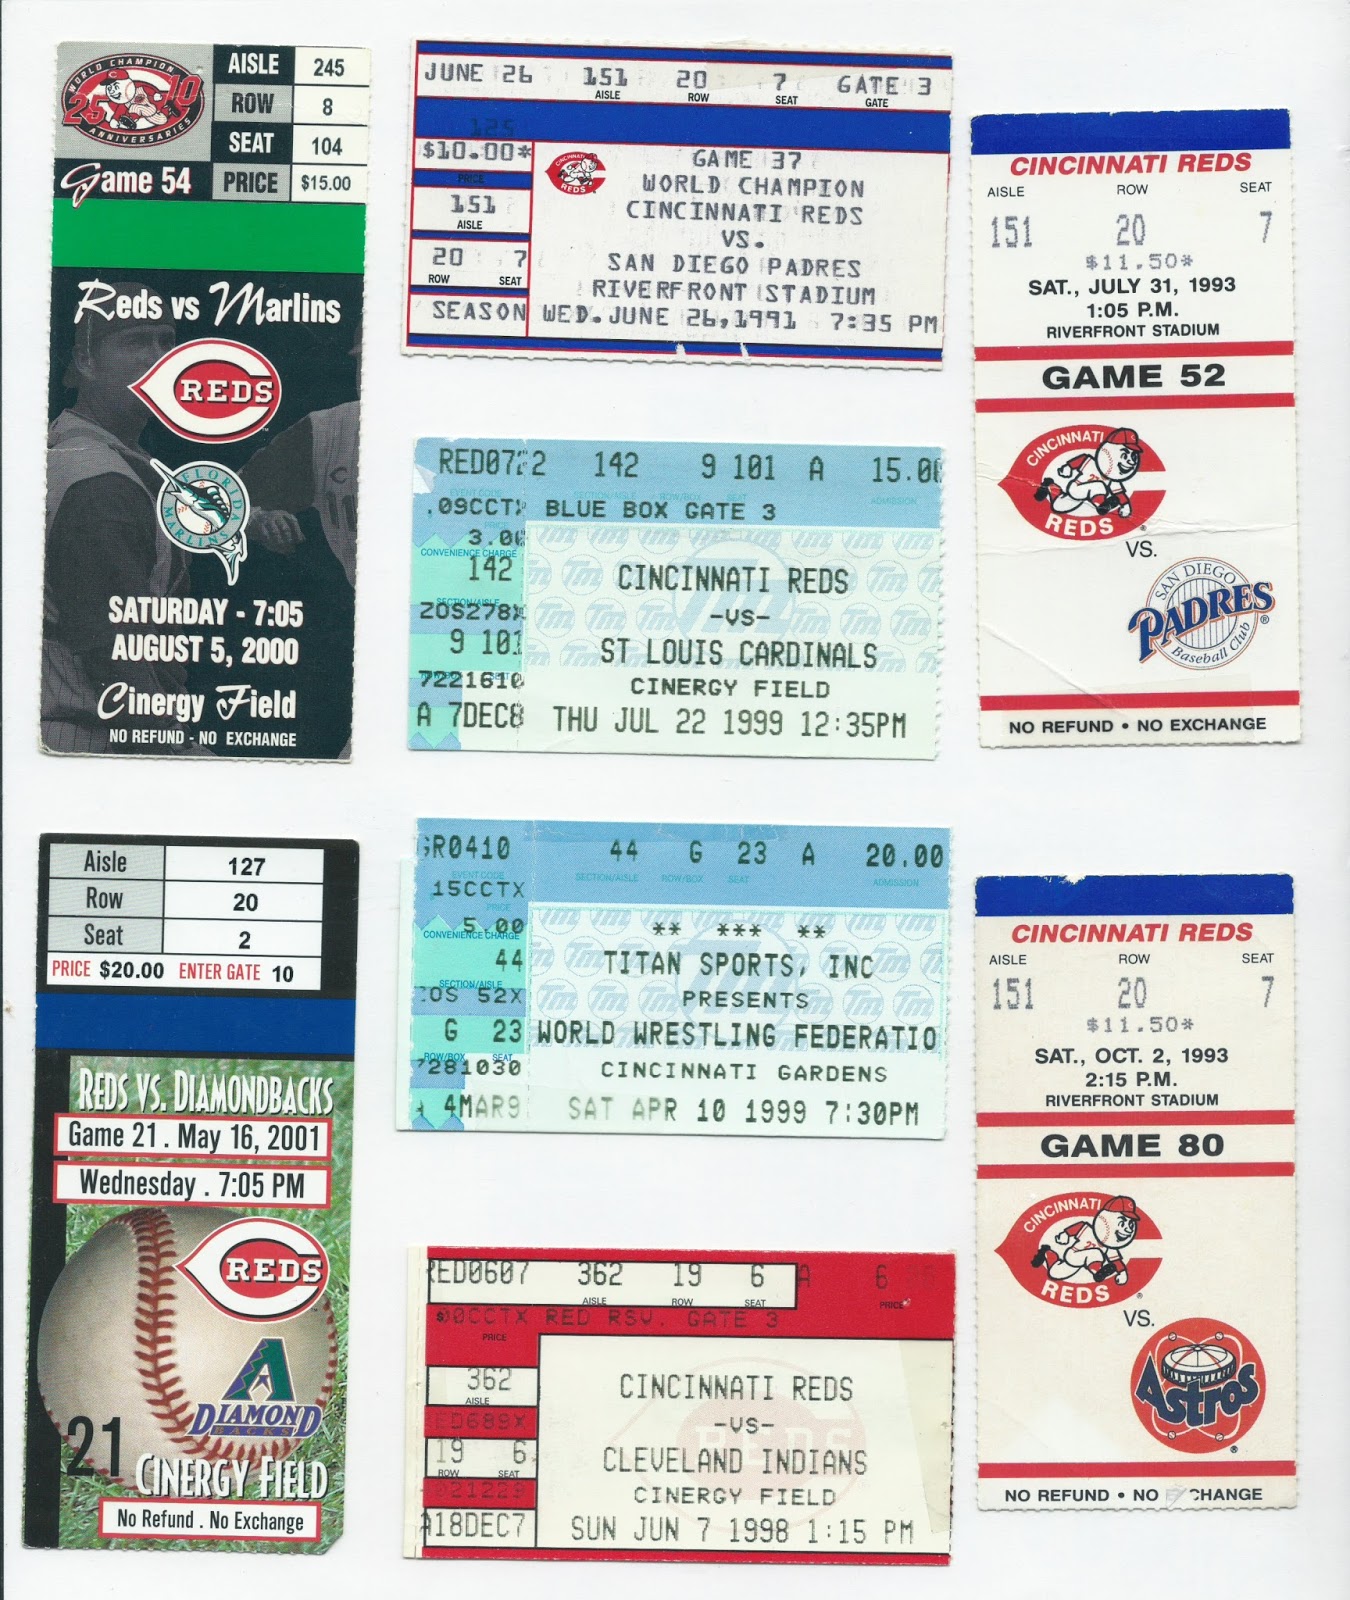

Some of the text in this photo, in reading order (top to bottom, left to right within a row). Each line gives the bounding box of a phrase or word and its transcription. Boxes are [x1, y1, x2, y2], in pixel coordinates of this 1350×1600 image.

[69, 57, 174, 94] WORLD CHAMPION
[228, 53, 344, 76] AISLE 245
[425, 63, 533, 83] JUNE 26
[595, 90, 888, 108] AISLE ROW SEAT GATE
[89, 118, 191, 144] ANNIVERSARIES
[693, 150, 801, 169] GAME 37
[1010, 153, 1252, 175] CINCINNATI REDS
[61, 163, 191, 209] Game 54
[223, 172, 351, 193] PRICE $15.00
[987, 182, 1272, 197] AISLE ROW SEAT
[608, 253, 861, 278] SAN DIEGO PADRES
[592, 279, 875, 305] RIVERFRONT STADIUM
[1029, 277, 1236, 296] SAT., JULY 31, 1993
[74, 278, 341, 326] Reds vs Marlins
[433, 301, 526, 321] SEASON
[1087, 303, 1178, 318] 1:05 P.M.
[831, 313, 891, 332] 7:35
[909, 315, 937, 333] PM
[1042, 364, 1226, 389] GAME 52
[180, 379, 273, 406] REDS
[595, 451, 639, 478] 142
[546, 501, 776, 520] BLUE BOX GATE 3
[421, 548, 517, 558] CONVENIENCE CHARGE
[618, 563, 849, 594] CINCINNATI REDS
[109, 596, 303, 627] SATURDAY 7:05
[710, 609, 770, 626] -VS-
[1128, 581, 1276, 663] PADRES
[111, 634, 299, 667] AUGUST 5, 2000
[601, 637, 877, 669] ST LOUIS CARDINALS
[1172, 622, 1250, 664] Baseball Club
[630, 677, 829, 698] CINERGY FIELD
[553, 706, 906, 738] THU JUL 22 1999 12:35PM
[110, 730, 296, 746] NO REFUND NO EXCHANGE
[84, 851, 266, 876] Aisle 127
[610, 839, 943, 867] 44 23 20.00
[424, 930, 520, 940] CONVENIENCE CHARGE
[1012, 923, 1253, 944] CINCINNATI REDS
[52, 960, 294, 982] PRICE $20.00 ENTER GATE 10
[604, 950, 873, 979] TITAN SPORTS, INC
[439, 980, 502, 989] SECTION/AISLE
[683, 991, 809, 1008] PRESENTS
[538, 1020, 936, 1050] WORLD WRESTLING FEDERATIO
[1035, 1048, 1228, 1065] SAT., OCT. 2, 1993
[601, 1061, 888, 1082] CINCINNATI GARDENS
[1086, 1072, 1177, 1087] 2:15 P.M.
[79, 1068, 334, 1116] REDS VS. DIAMONDBACKS
[1046, 1094, 1219, 1106] RIVERFRONT STADIUM
[569, 1097, 918, 1126] SAT APR 10 1999 7:30PM
[69, 1121, 319, 1153] Game 21 May 16, 2001
[1041, 1134, 1224, 1157] GAME 80
[80, 1169, 304, 1199] Wednesday 7:05 PM
[583, 1297, 606, 1305] AISLE
[672, 1298, 693, 1307] ROW
[620, 1373, 853, 1401] CINCINNATI REDS
[1135, 1353, 1262, 1427] Astros
[603, 1446, 867, 1475] CLEVELAND INDIANS
[135, 1453, 329, 1499] CINERGY FIELD
[634, 1486, 836, 1505] CINERGY FIELD
[117, 1509, 304, 1534] No Refund No Exchange
[571, 1516, 913, 1544] SUN JUN 7 1998 1:15 PM
